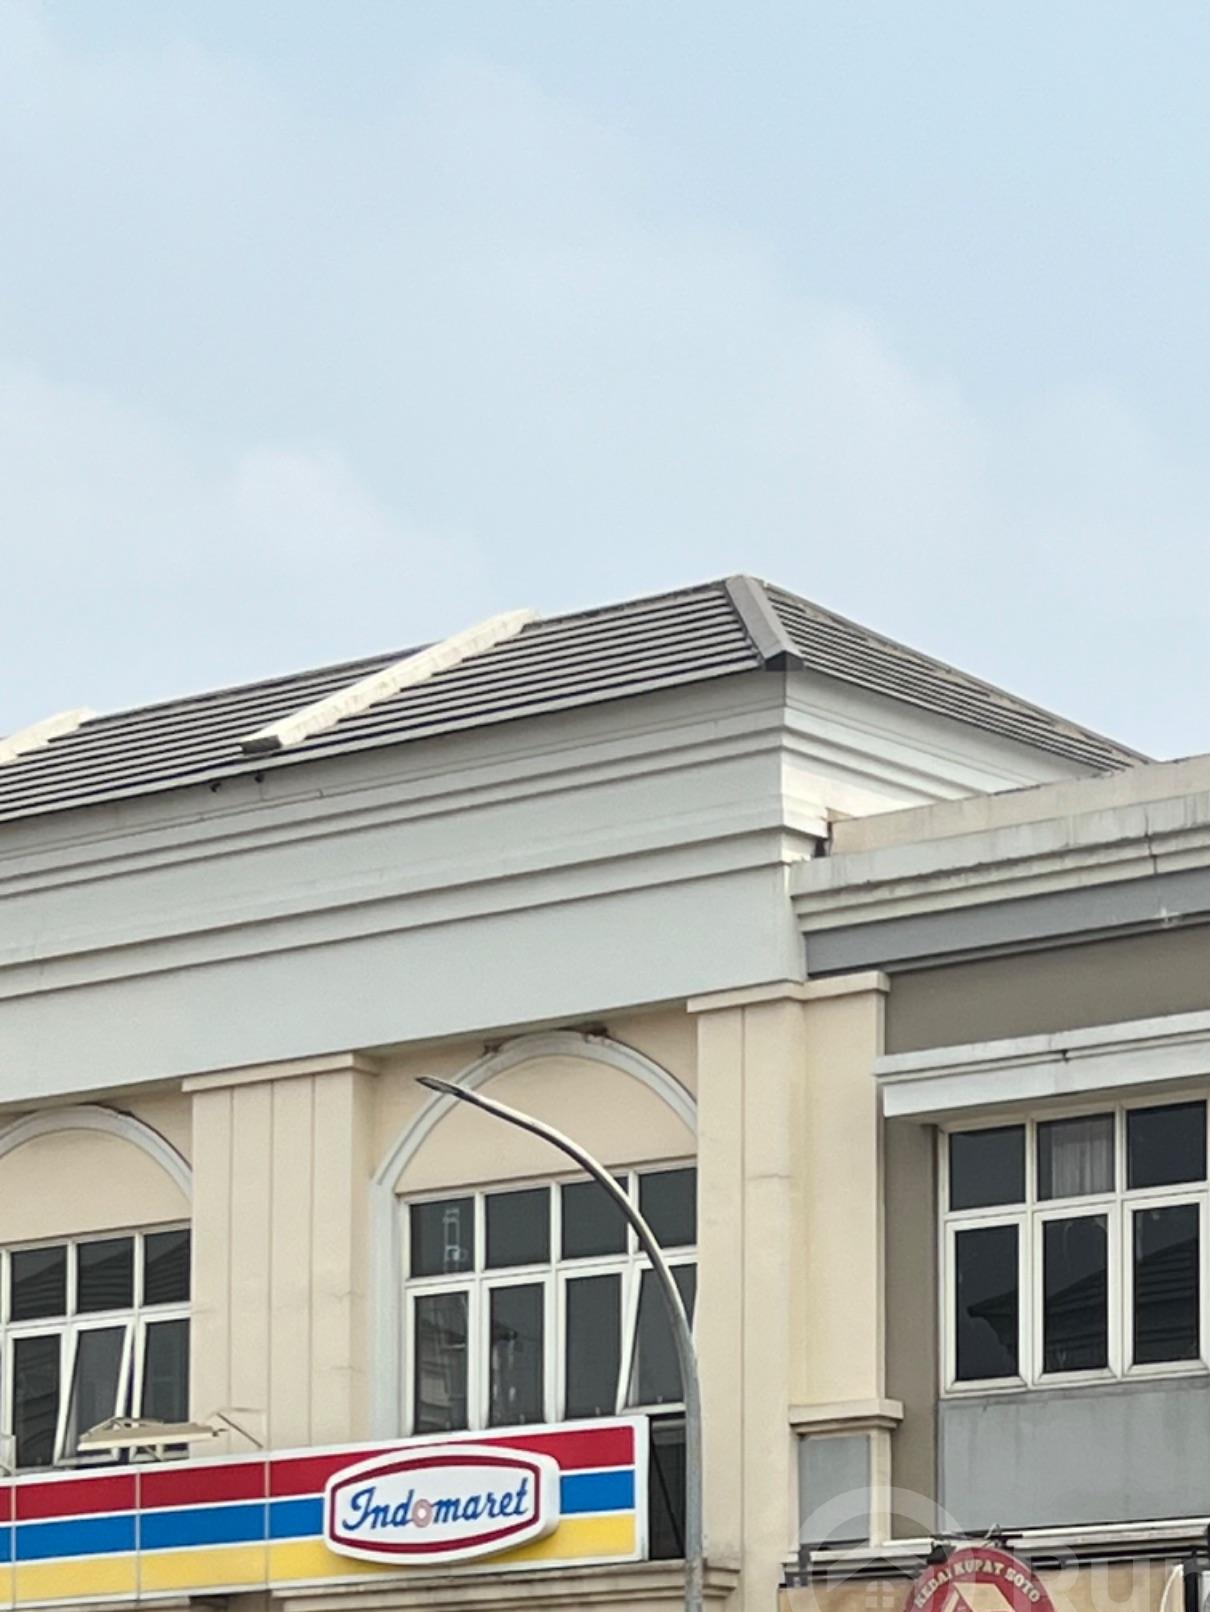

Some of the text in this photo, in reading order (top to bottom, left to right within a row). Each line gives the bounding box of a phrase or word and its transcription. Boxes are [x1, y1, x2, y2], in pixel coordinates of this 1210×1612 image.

[341, 1476, 529, 1531] Indomaret
[914, 1559, 1041, 1609] KEDAI KUPAT SOTO
